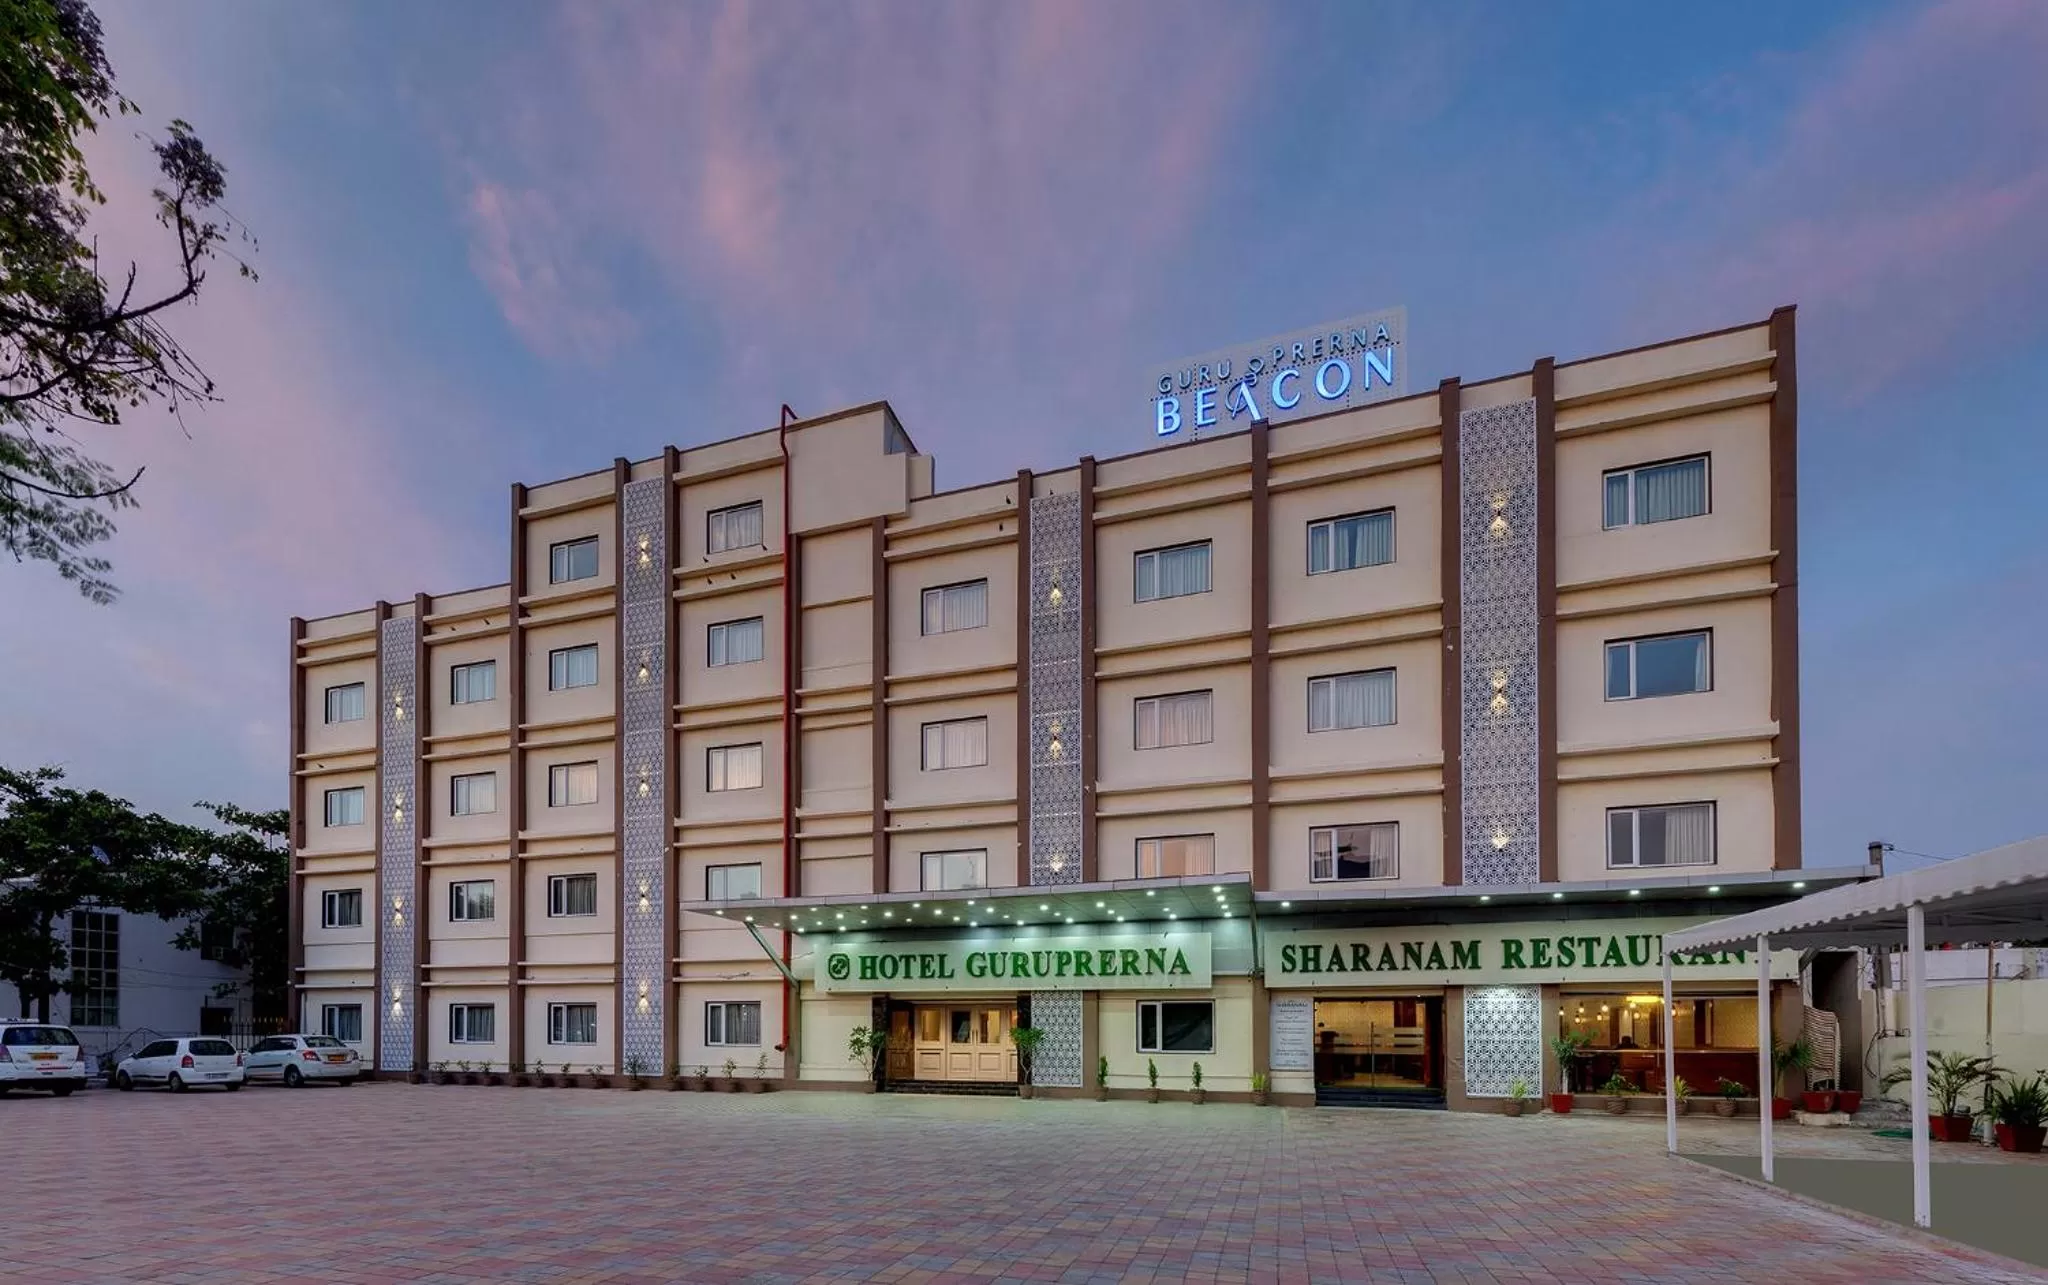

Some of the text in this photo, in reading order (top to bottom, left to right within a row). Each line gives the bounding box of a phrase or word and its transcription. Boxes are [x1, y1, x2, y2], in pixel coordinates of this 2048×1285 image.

[1158, 323, 1391, 394] GURU PRERNA
[1156, 347, 1393, 436] BEACON
[859, 947, 1192, 980] HOTEL GURUPRERNA
[1281, 934, 1772, 973] SHARANAM RESTAU
